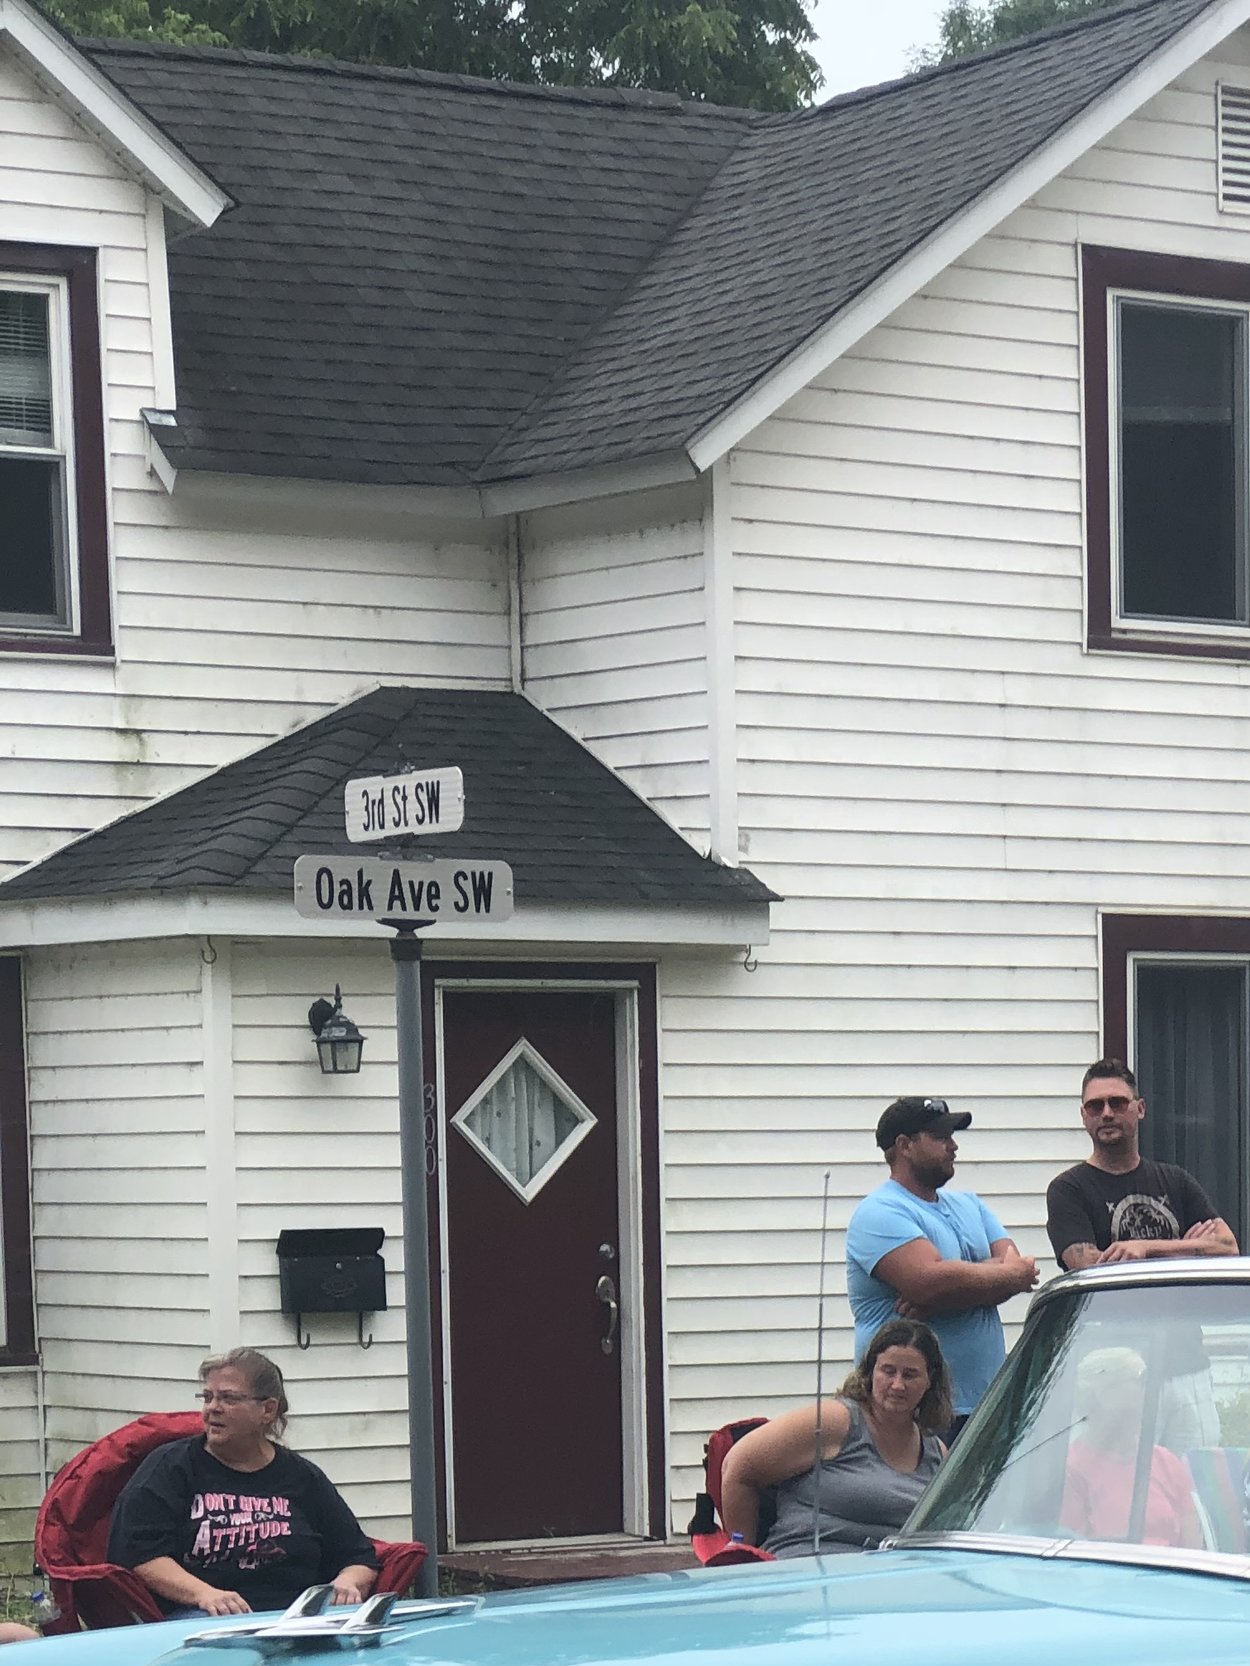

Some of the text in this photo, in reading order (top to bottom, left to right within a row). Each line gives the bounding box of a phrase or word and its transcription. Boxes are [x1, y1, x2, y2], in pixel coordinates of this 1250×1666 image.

[361, 780, 441, 831] 3rd St SW
[315, 866, 493, 913] Oak Ave SW
[422, 1083, 436, 1175] 300
[229, 1511, 254, 1526] YOUR
[239, 1495, 272, 1513] GIVE
[272, 1496, 292, 1517] ME
[191, 1520, 292, 1556] ATTITUDE
